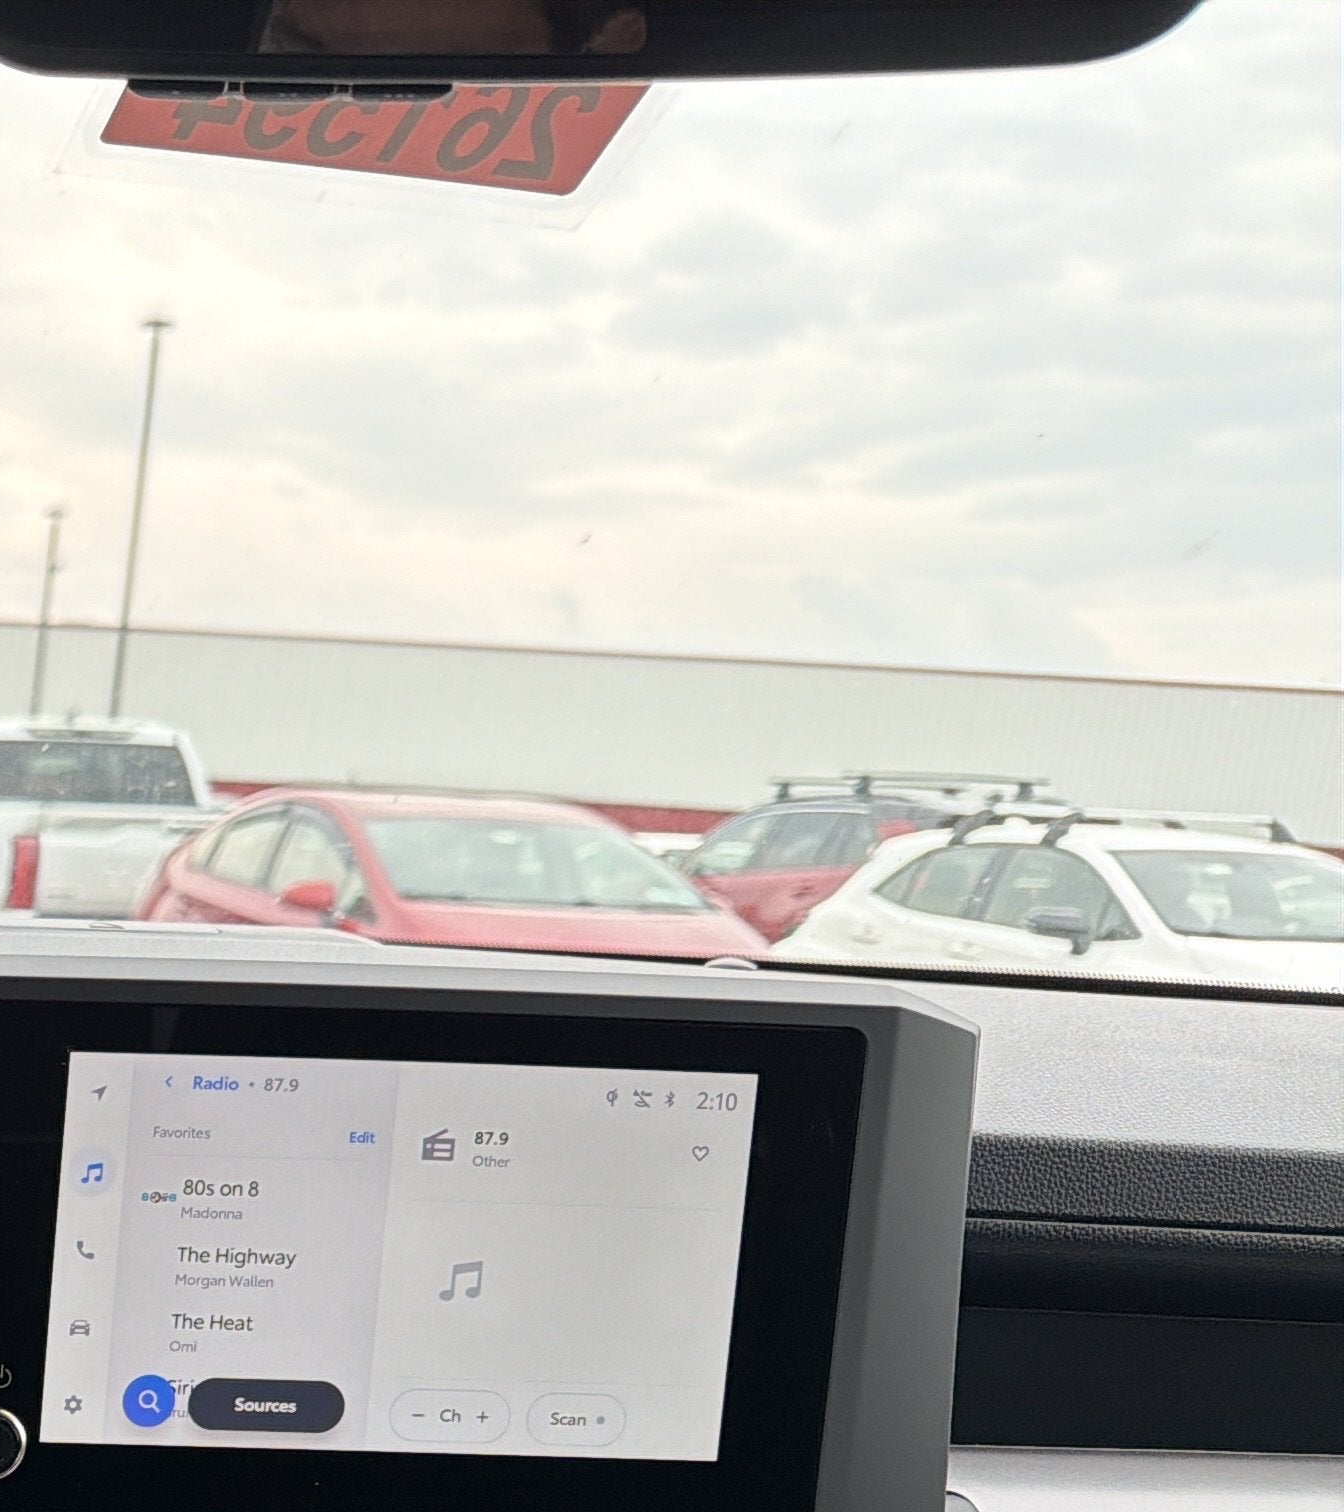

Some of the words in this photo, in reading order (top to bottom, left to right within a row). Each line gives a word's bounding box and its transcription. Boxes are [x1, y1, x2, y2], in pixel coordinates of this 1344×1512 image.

[193, 1076, 239, 1091] Radio
[263, 1078, 299, 1093] 87.9
[696, 1091, 738, 1111] 2:10
[153, 1126, 211, 1140] Favorites
[349, 1132, 376, 1144] Edit
[474, 1131, 509, 1146] 87.9
[472, 1155, 510, 1168] Other
[183, 1180, 214, 1197] 80s
[220, 1184, 243, 1197] on
[248, 1180, 259, 1197] 8
[181, 1207, 242, 1220] Madonna
[178, 1247, 211, 1263] The
[216, 1248, 297, 1269] Highway
[175, 1274, 226, 1289] Morgan
[228, 1275, 274, 1288] Wallen
[171, 1314, 204, 1330] The
[209, 1315, 253, 1331] Heat
[169, 1340, 197, 1352] Omi
[234, 1397, 297, 1414] Sources
[440, 1409, 461, 1423] Ch
[550, 1412, 587, 1426] Scan
